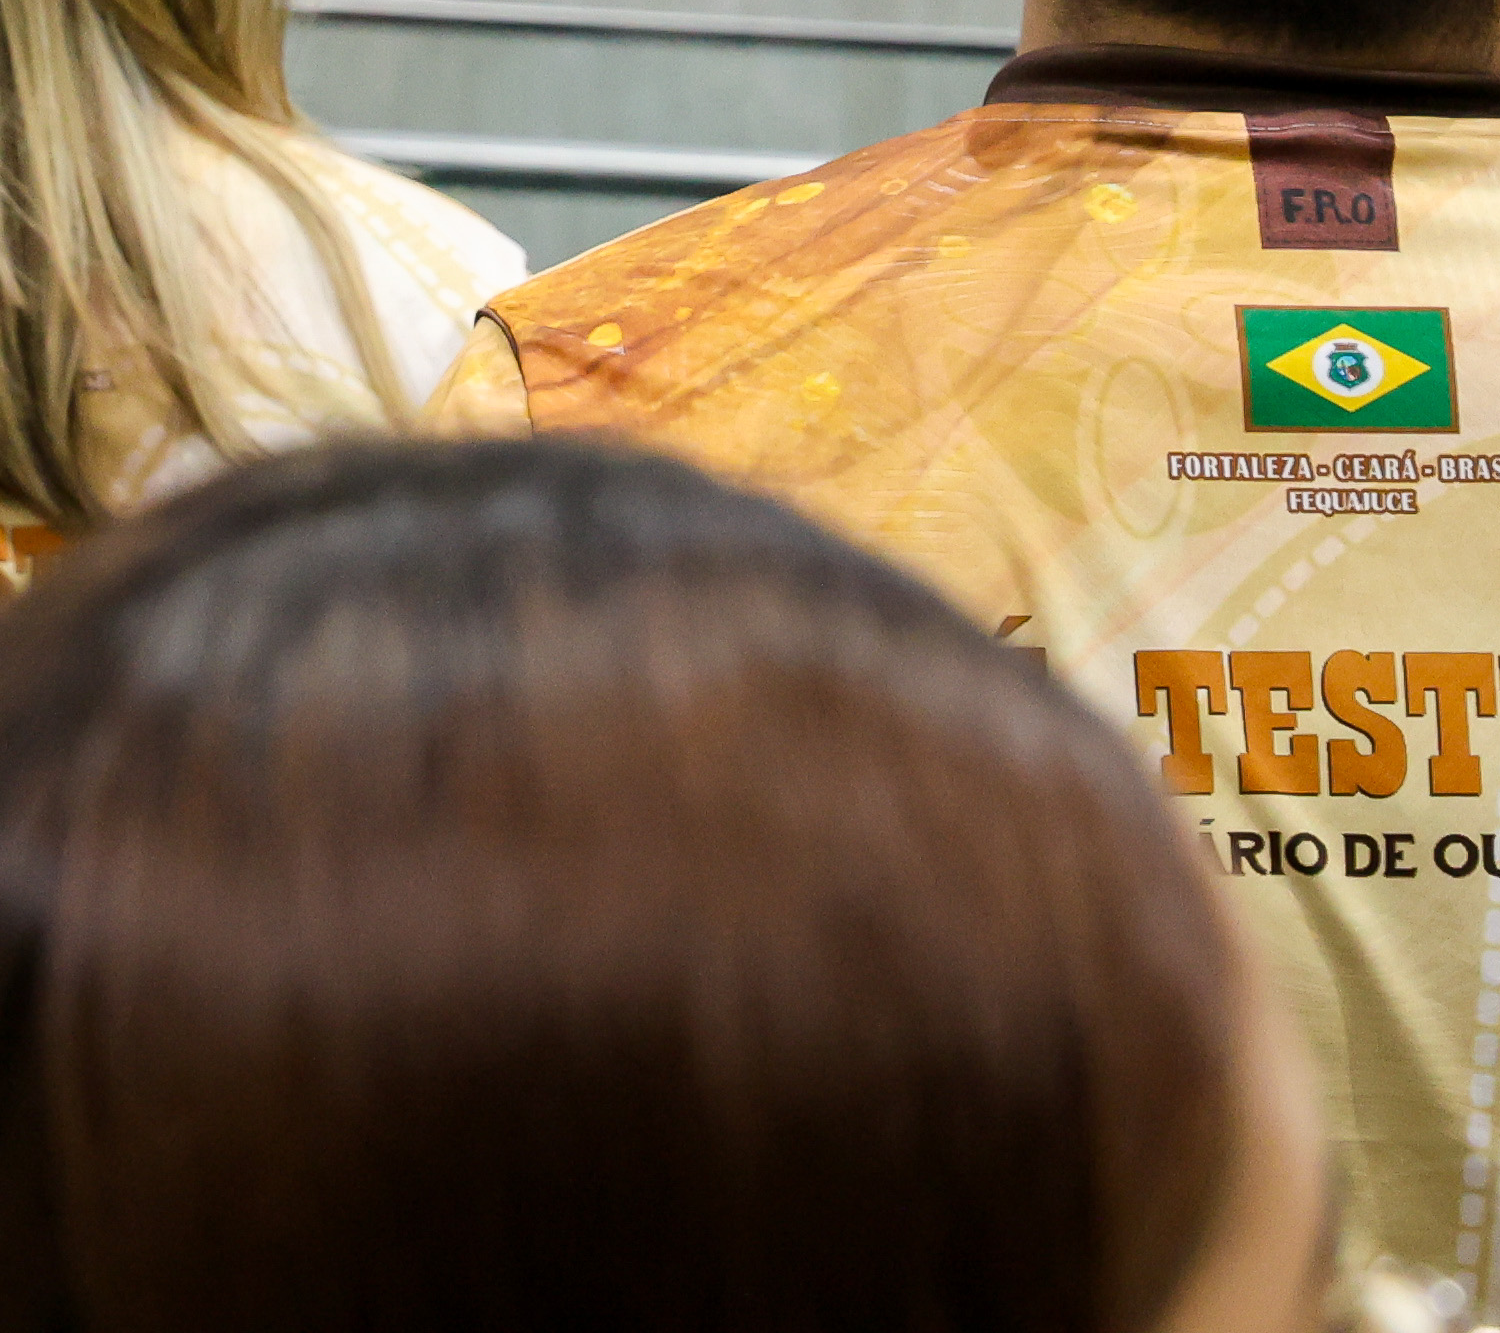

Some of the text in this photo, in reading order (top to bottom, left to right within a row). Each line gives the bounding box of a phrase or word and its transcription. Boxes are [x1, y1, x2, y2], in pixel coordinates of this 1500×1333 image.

[1168, 452, 1314, 482] FORTALEZA
[1332, 450, 1420, 481] CEARÁ
[1343, 833, 1417, 879] DE
